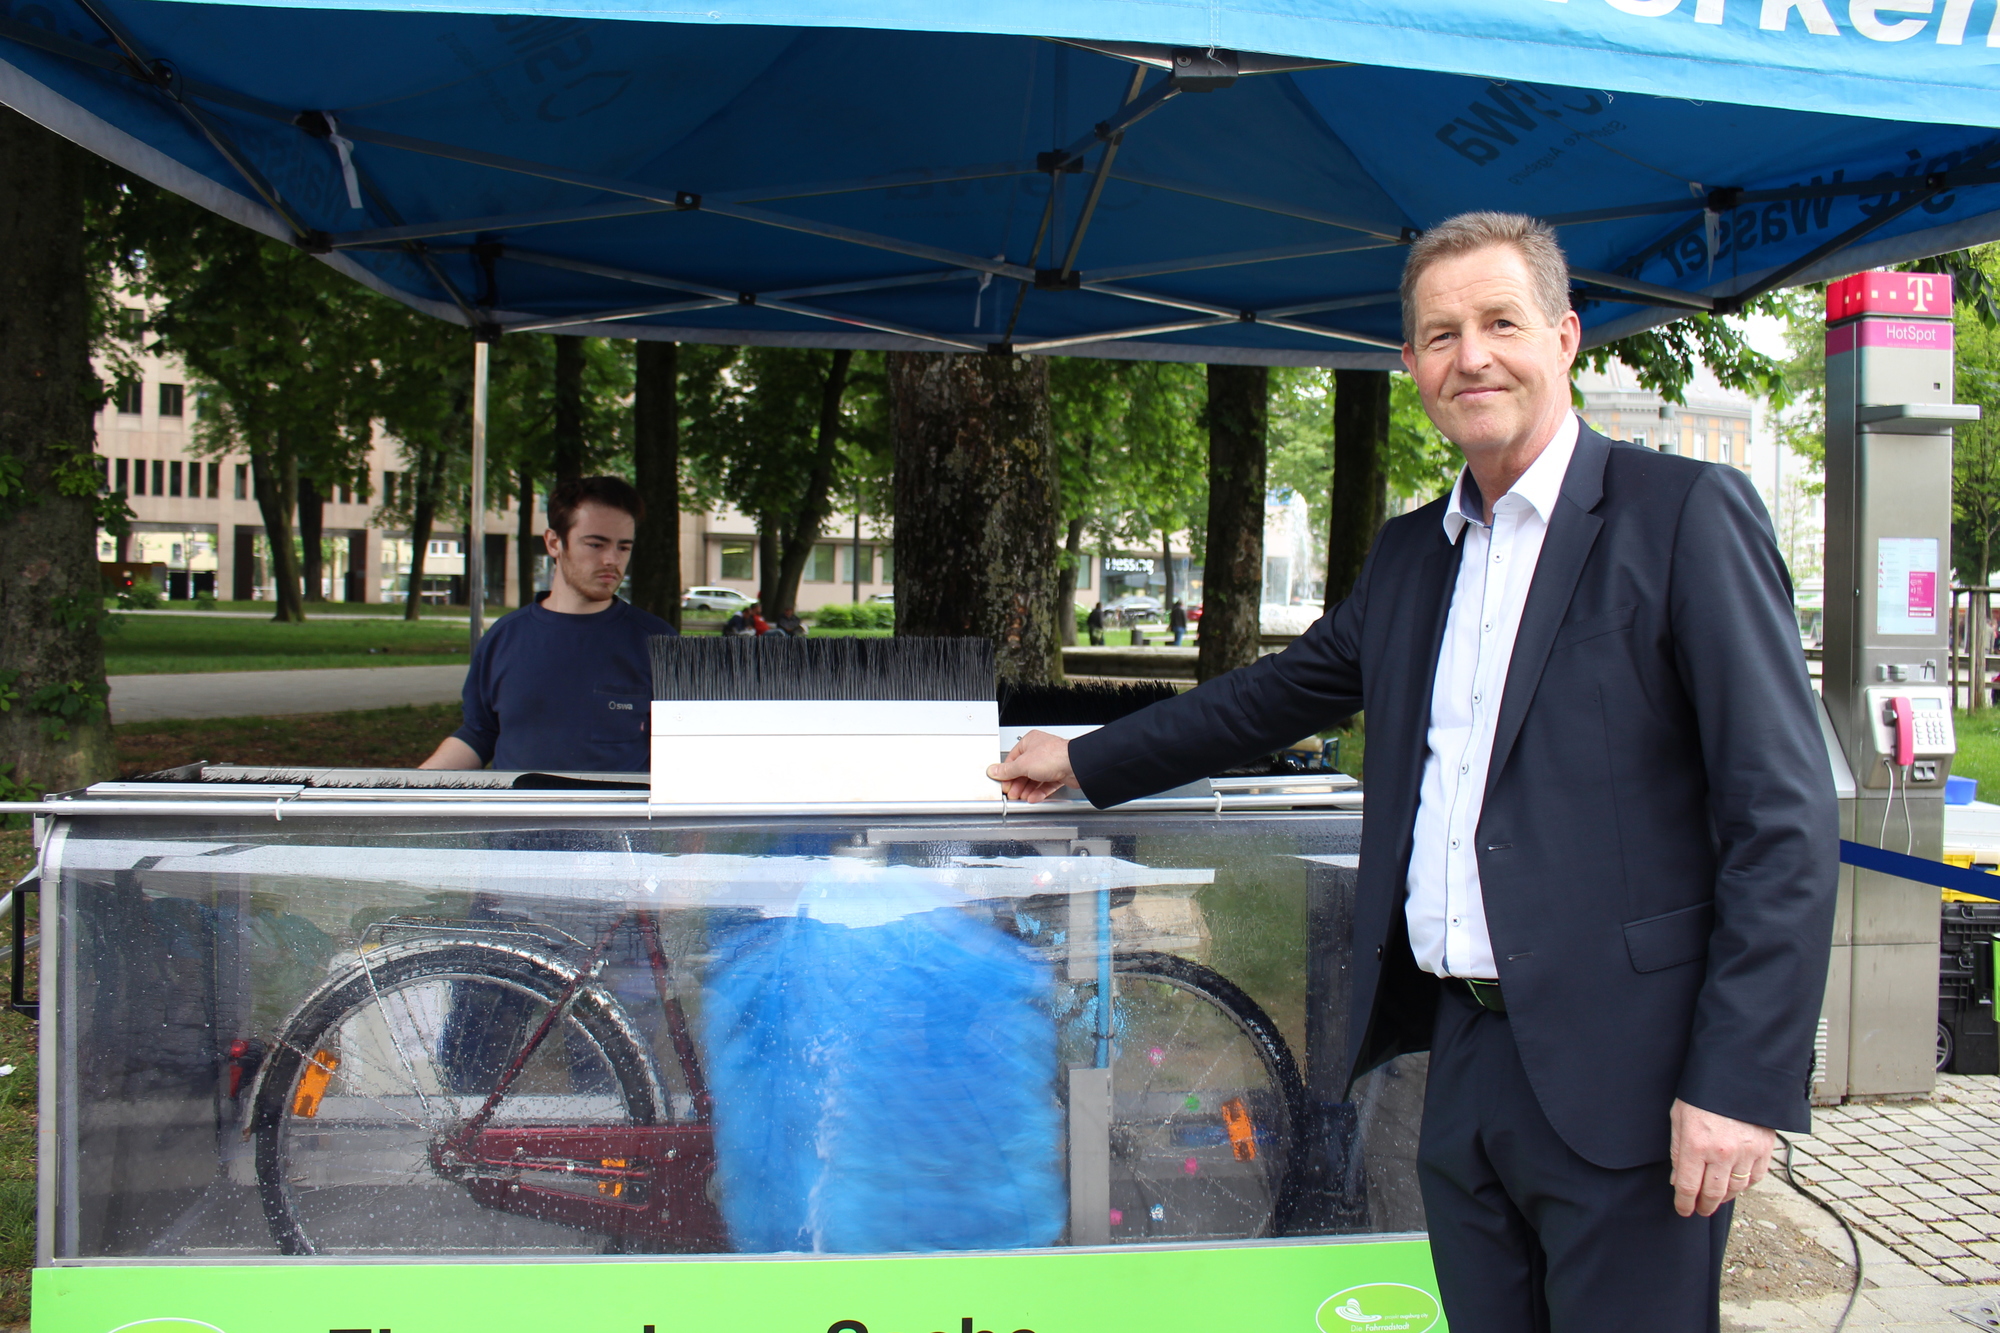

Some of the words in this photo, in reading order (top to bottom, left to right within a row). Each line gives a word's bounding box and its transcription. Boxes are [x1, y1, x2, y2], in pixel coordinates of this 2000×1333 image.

[1886, 324, 1936, 343] HotSpot
[1350, 1324, 1363, 1332] Die
[1365, 1321, 1410, 1331] Fahrradstadt
